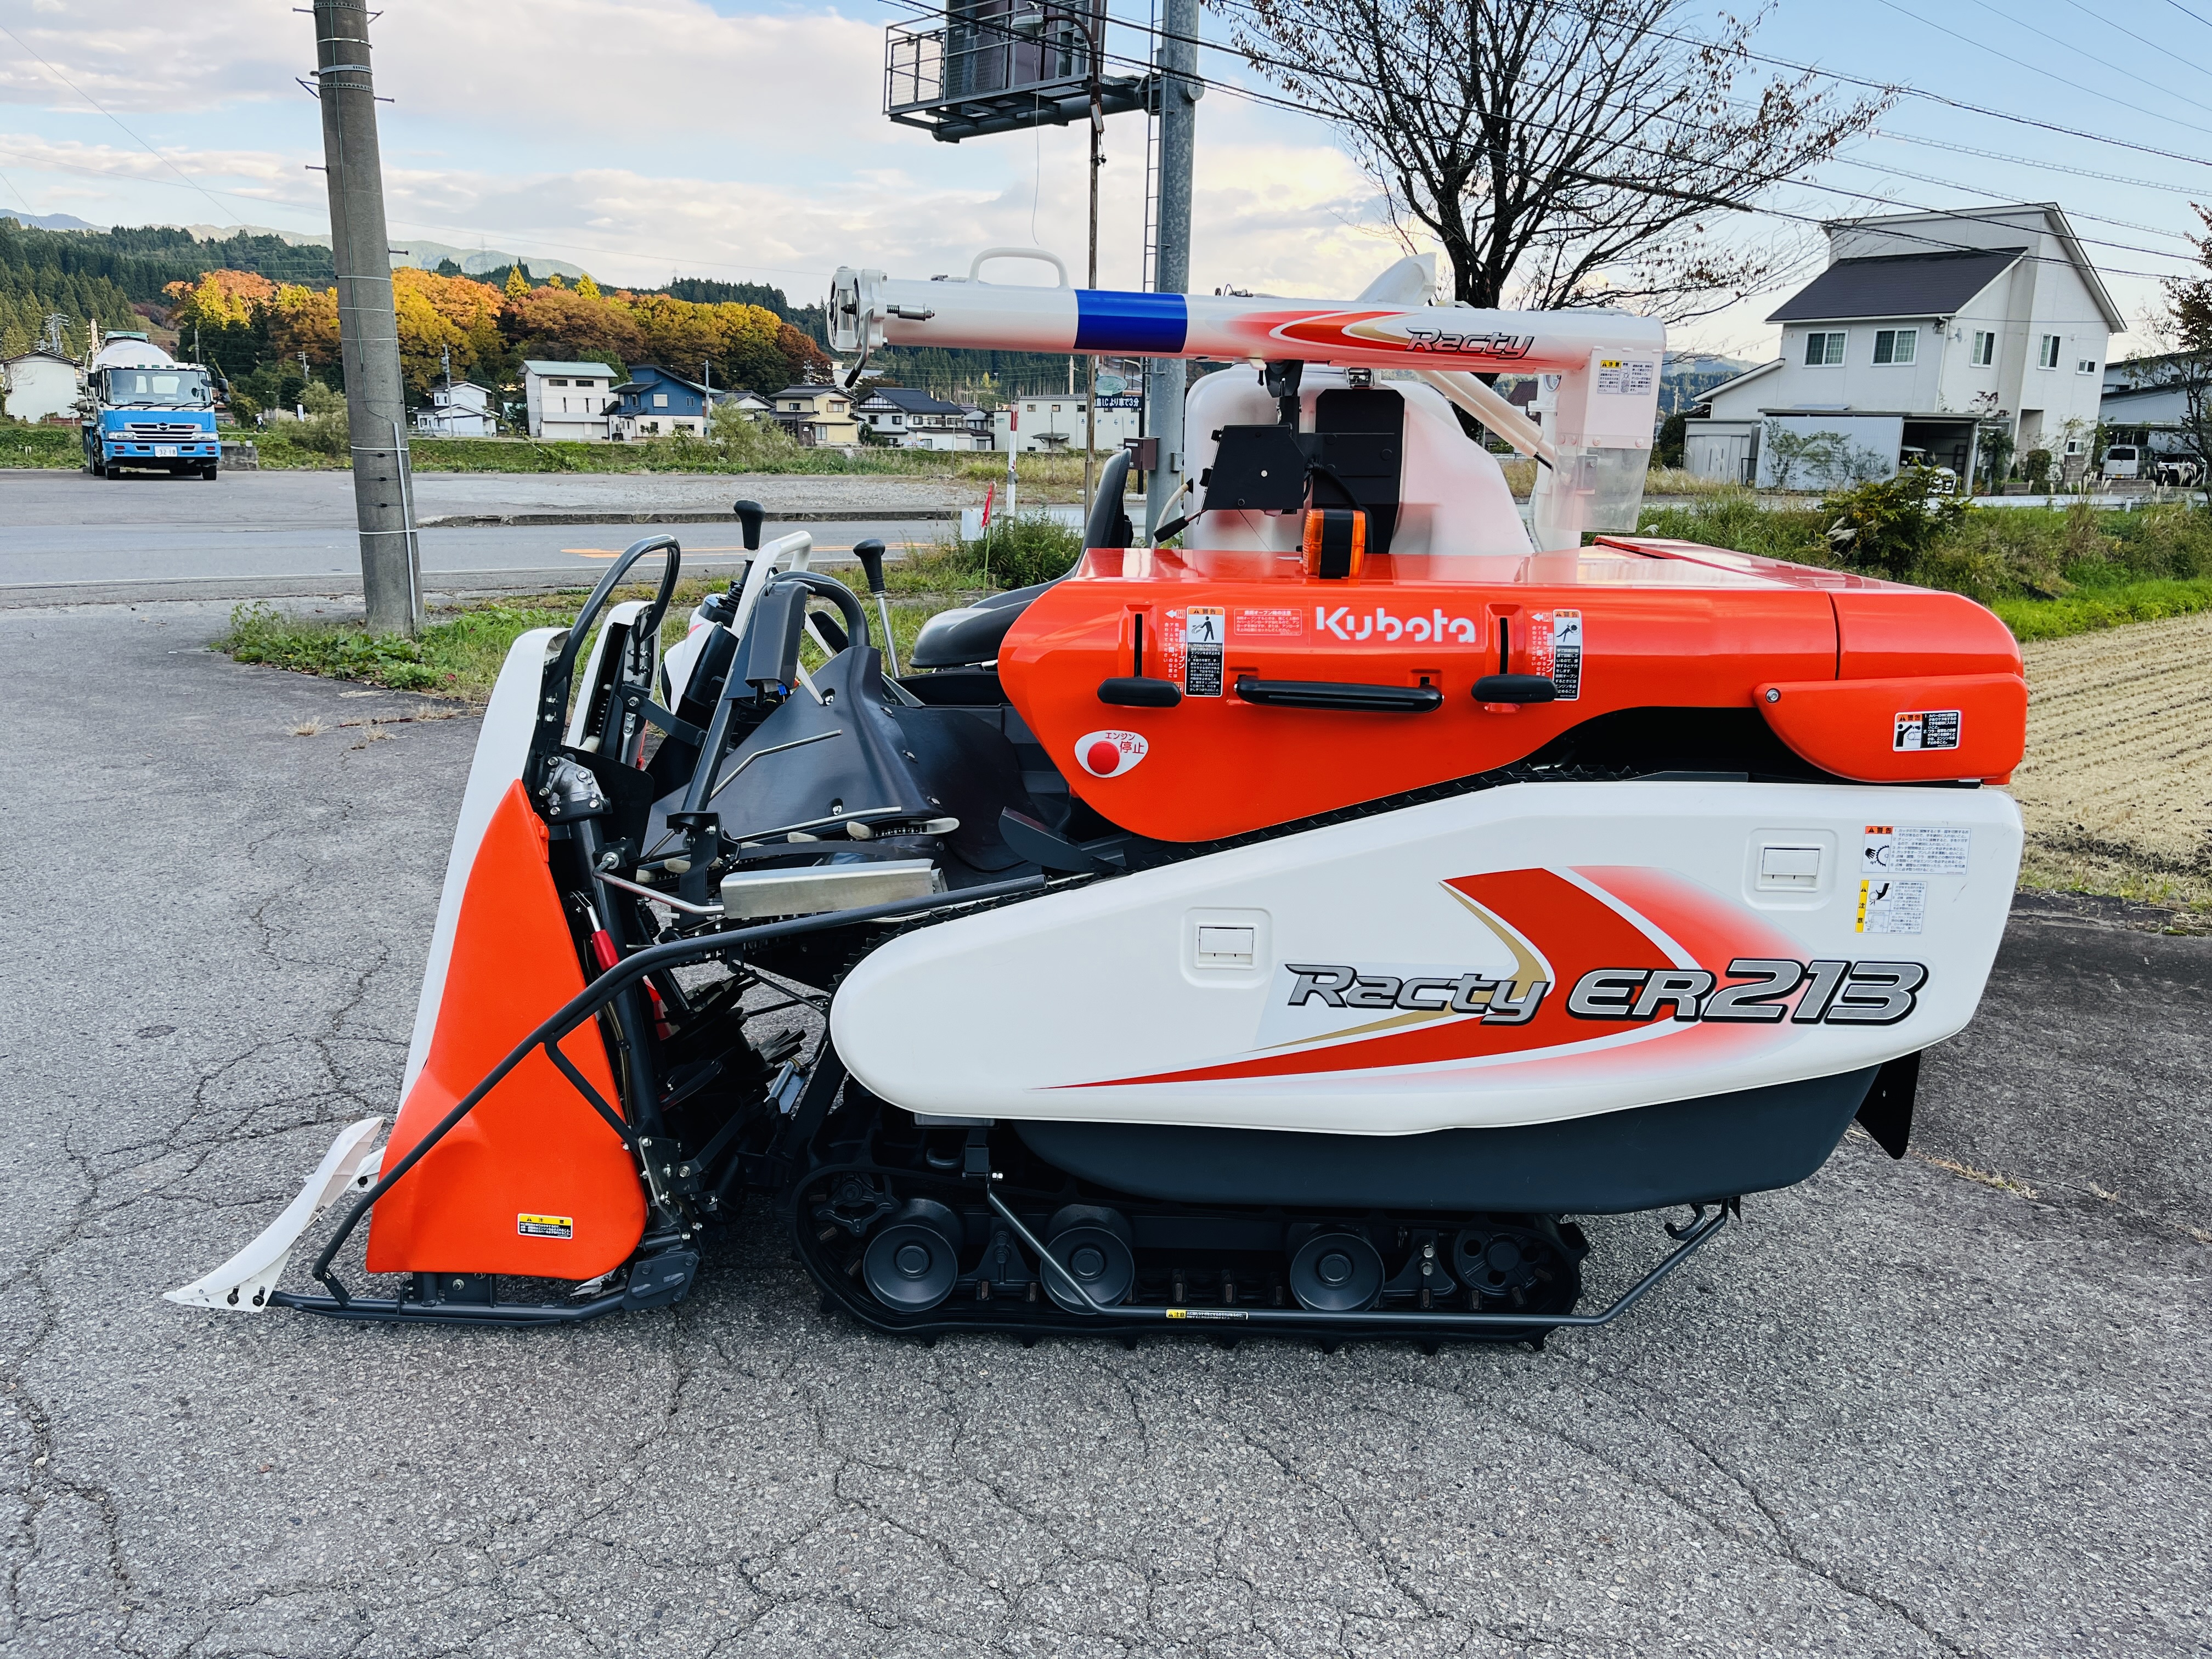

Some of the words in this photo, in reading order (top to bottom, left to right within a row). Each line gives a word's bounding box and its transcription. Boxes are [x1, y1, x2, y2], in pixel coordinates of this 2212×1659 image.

[1405, 327, 1535, 360] Racty
[1316, 606, 1476, 643] Kubota
[1105, 732, 1135, 741] エンジン
[1120, 741, 1145, 754] 停止
[1285, 964, 1551, 1026] Racty
[1566, 958, 1929, 1025] ER213
